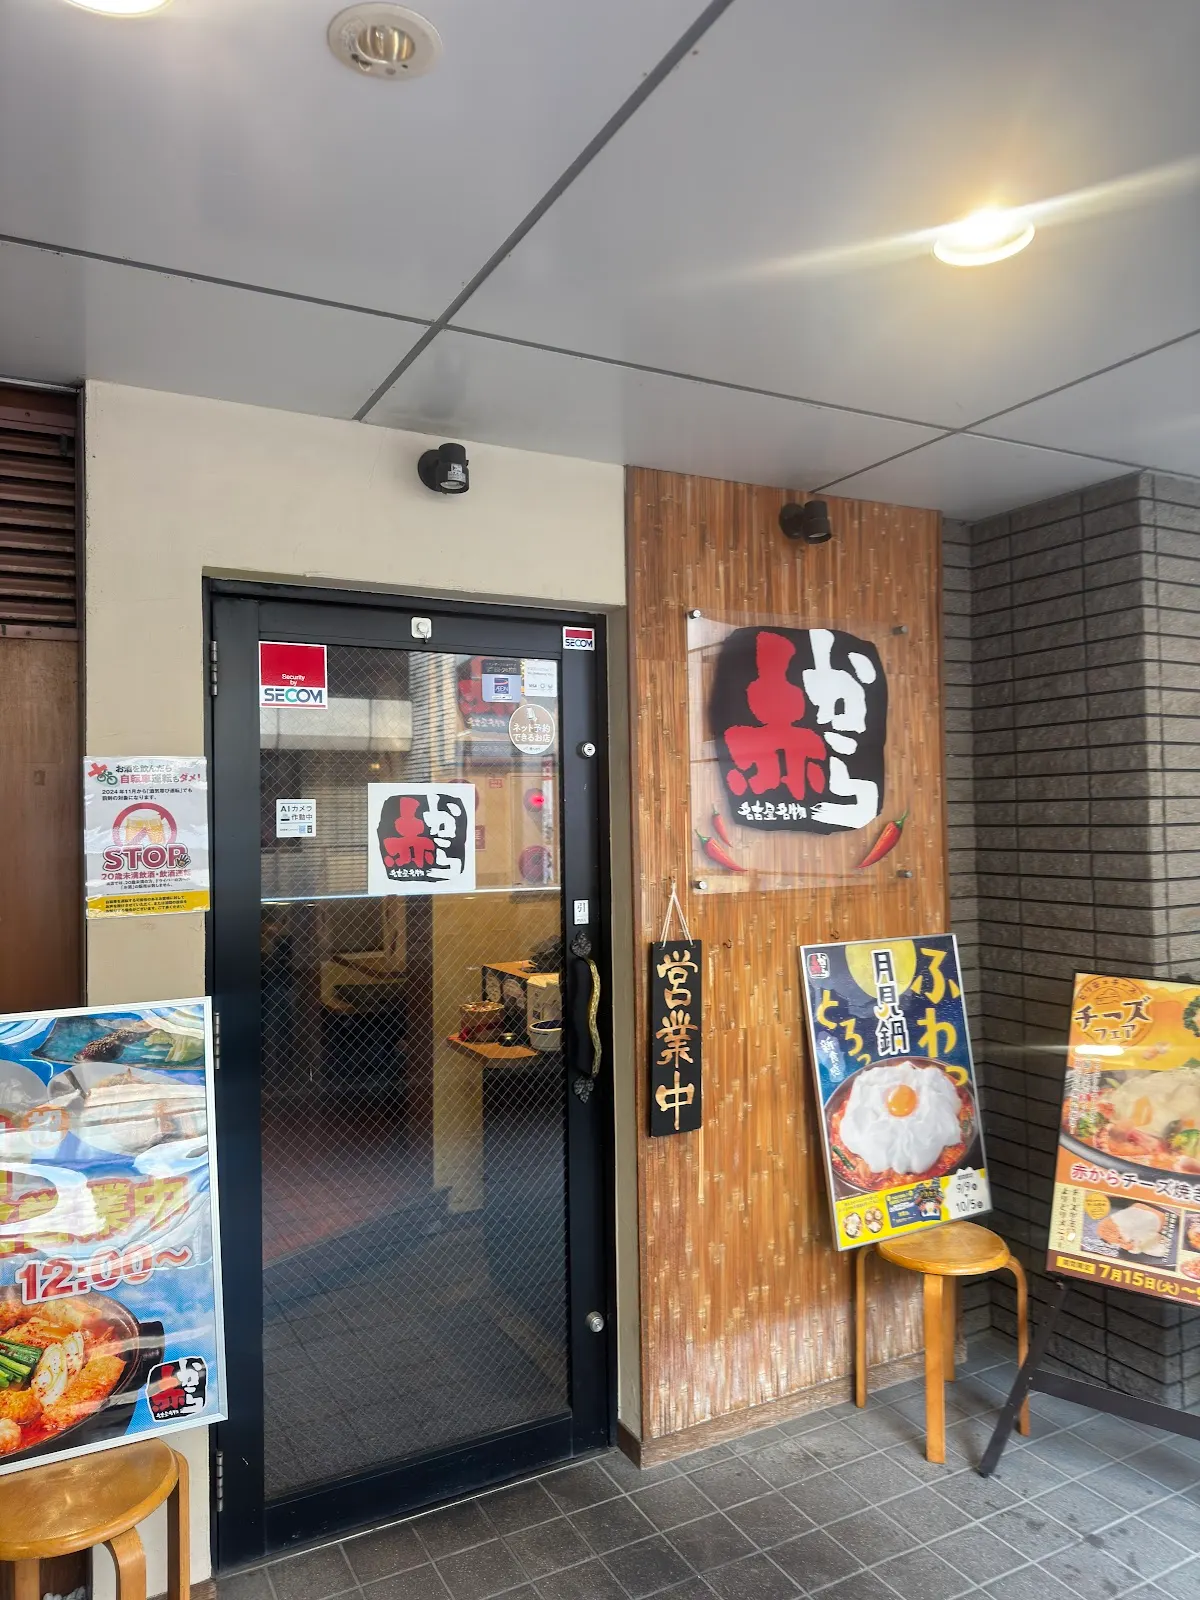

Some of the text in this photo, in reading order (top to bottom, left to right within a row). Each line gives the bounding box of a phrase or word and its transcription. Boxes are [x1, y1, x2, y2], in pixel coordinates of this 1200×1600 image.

[565, 639, 593, 648] SECOM
[281, 673, 305, 682] Security
[264, 687, 323, 703] SECOM
[512, 723, 551, 733] ネット予約
[723, 629, 879, 829] 赤から
[513, 733, 551, 743] できるお店
[280, 805, 313, 813] AIカメラ
[103, 843, 188, 872] STOP
[577, 902, 586, 913] 引
[872, 950, 910, 1056] 月見鍋
[911, 947, 968, 1086] ふわっ
[1074, 995, 1151, 1030] チーズ
[1094, 1024, 1136, 1039] フェア
[655, 950, 698, 1130] 営業中
